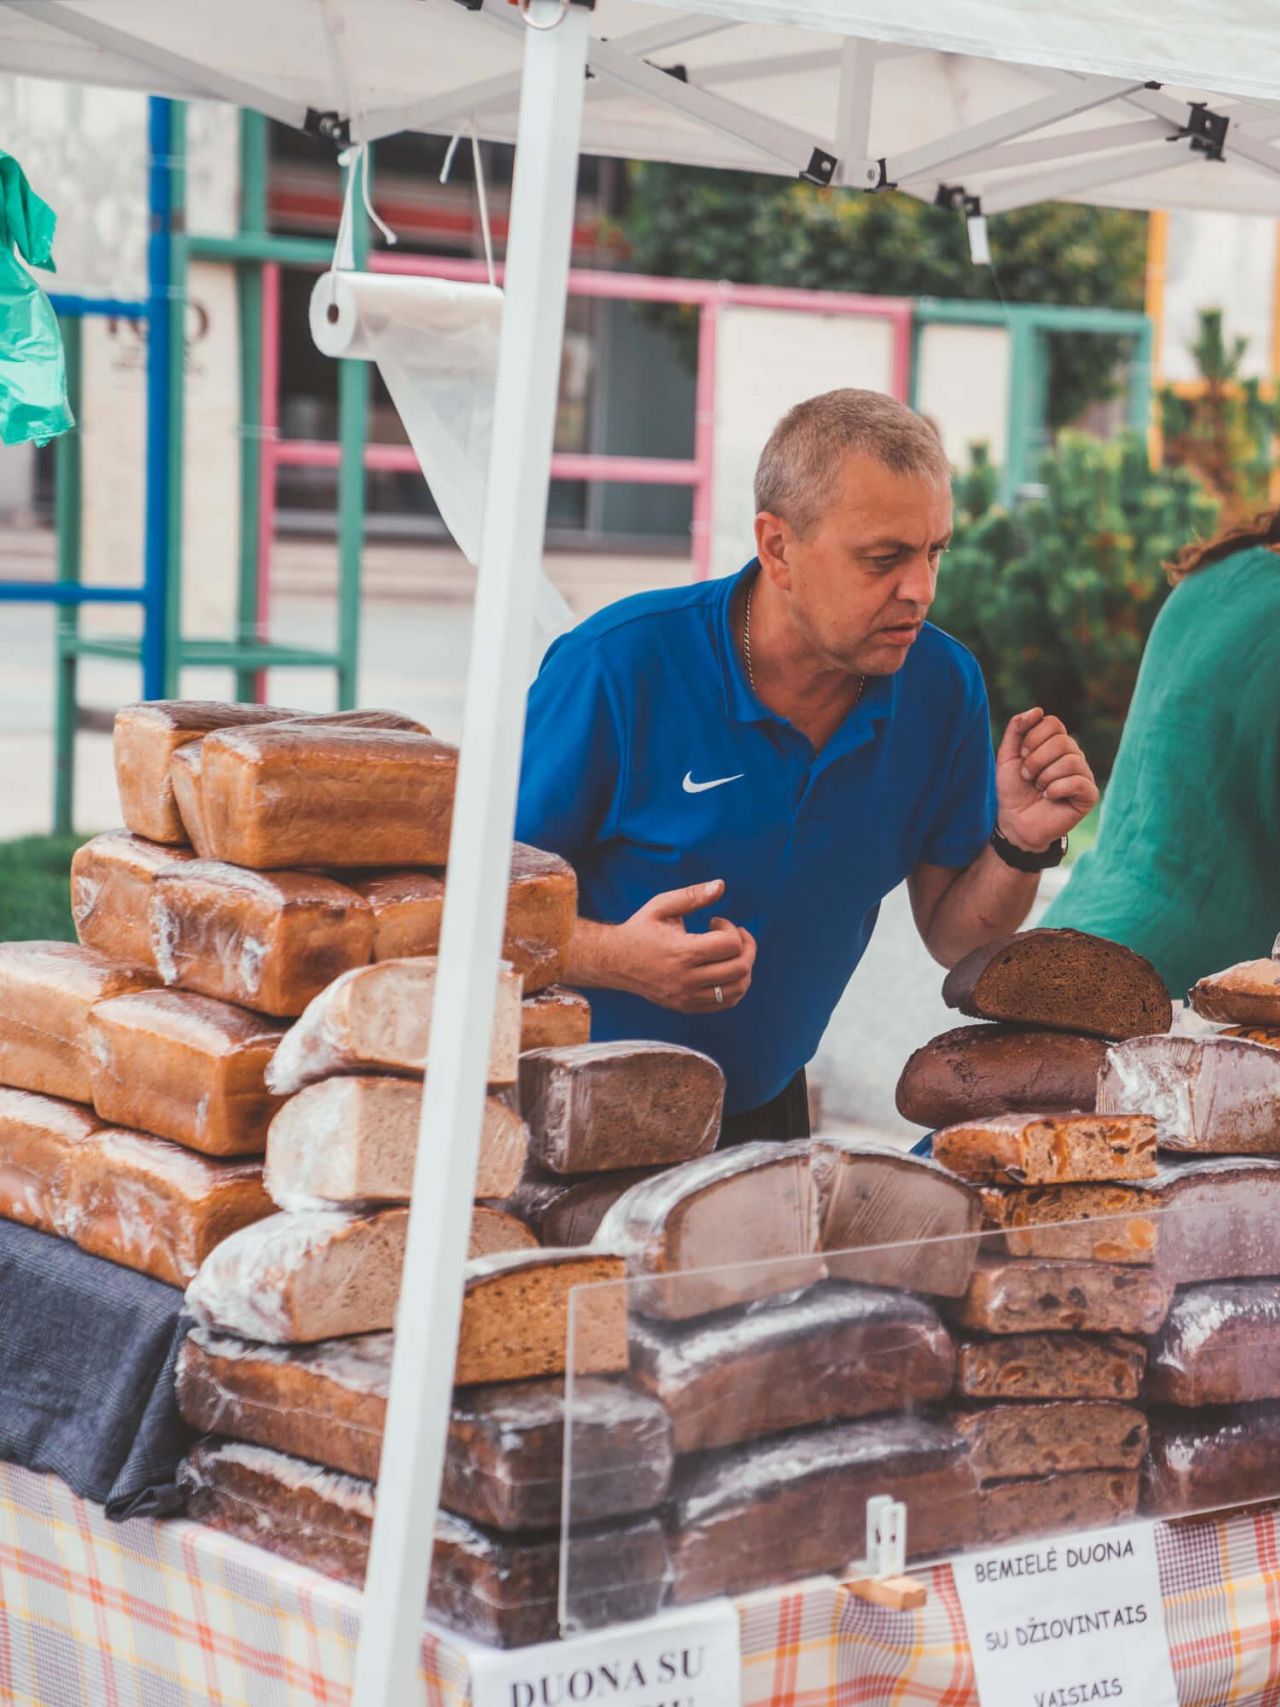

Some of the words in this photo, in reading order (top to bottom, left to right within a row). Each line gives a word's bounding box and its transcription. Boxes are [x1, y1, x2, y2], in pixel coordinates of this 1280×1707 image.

[974, 1546, 1058, 1584] BEMIELĖ
[1066, 1539, 1135, 1569] DUONA
[985, 1629, 1009, 1652] SU
[1015, 1604, 1148, 1647] DŽIOVINTAIS
[511, 1659, 646, 1707] DUONA
[657, 1646, 704, 1684] SU
[1034, 1678, 1123, 1707] VAISIAIS
